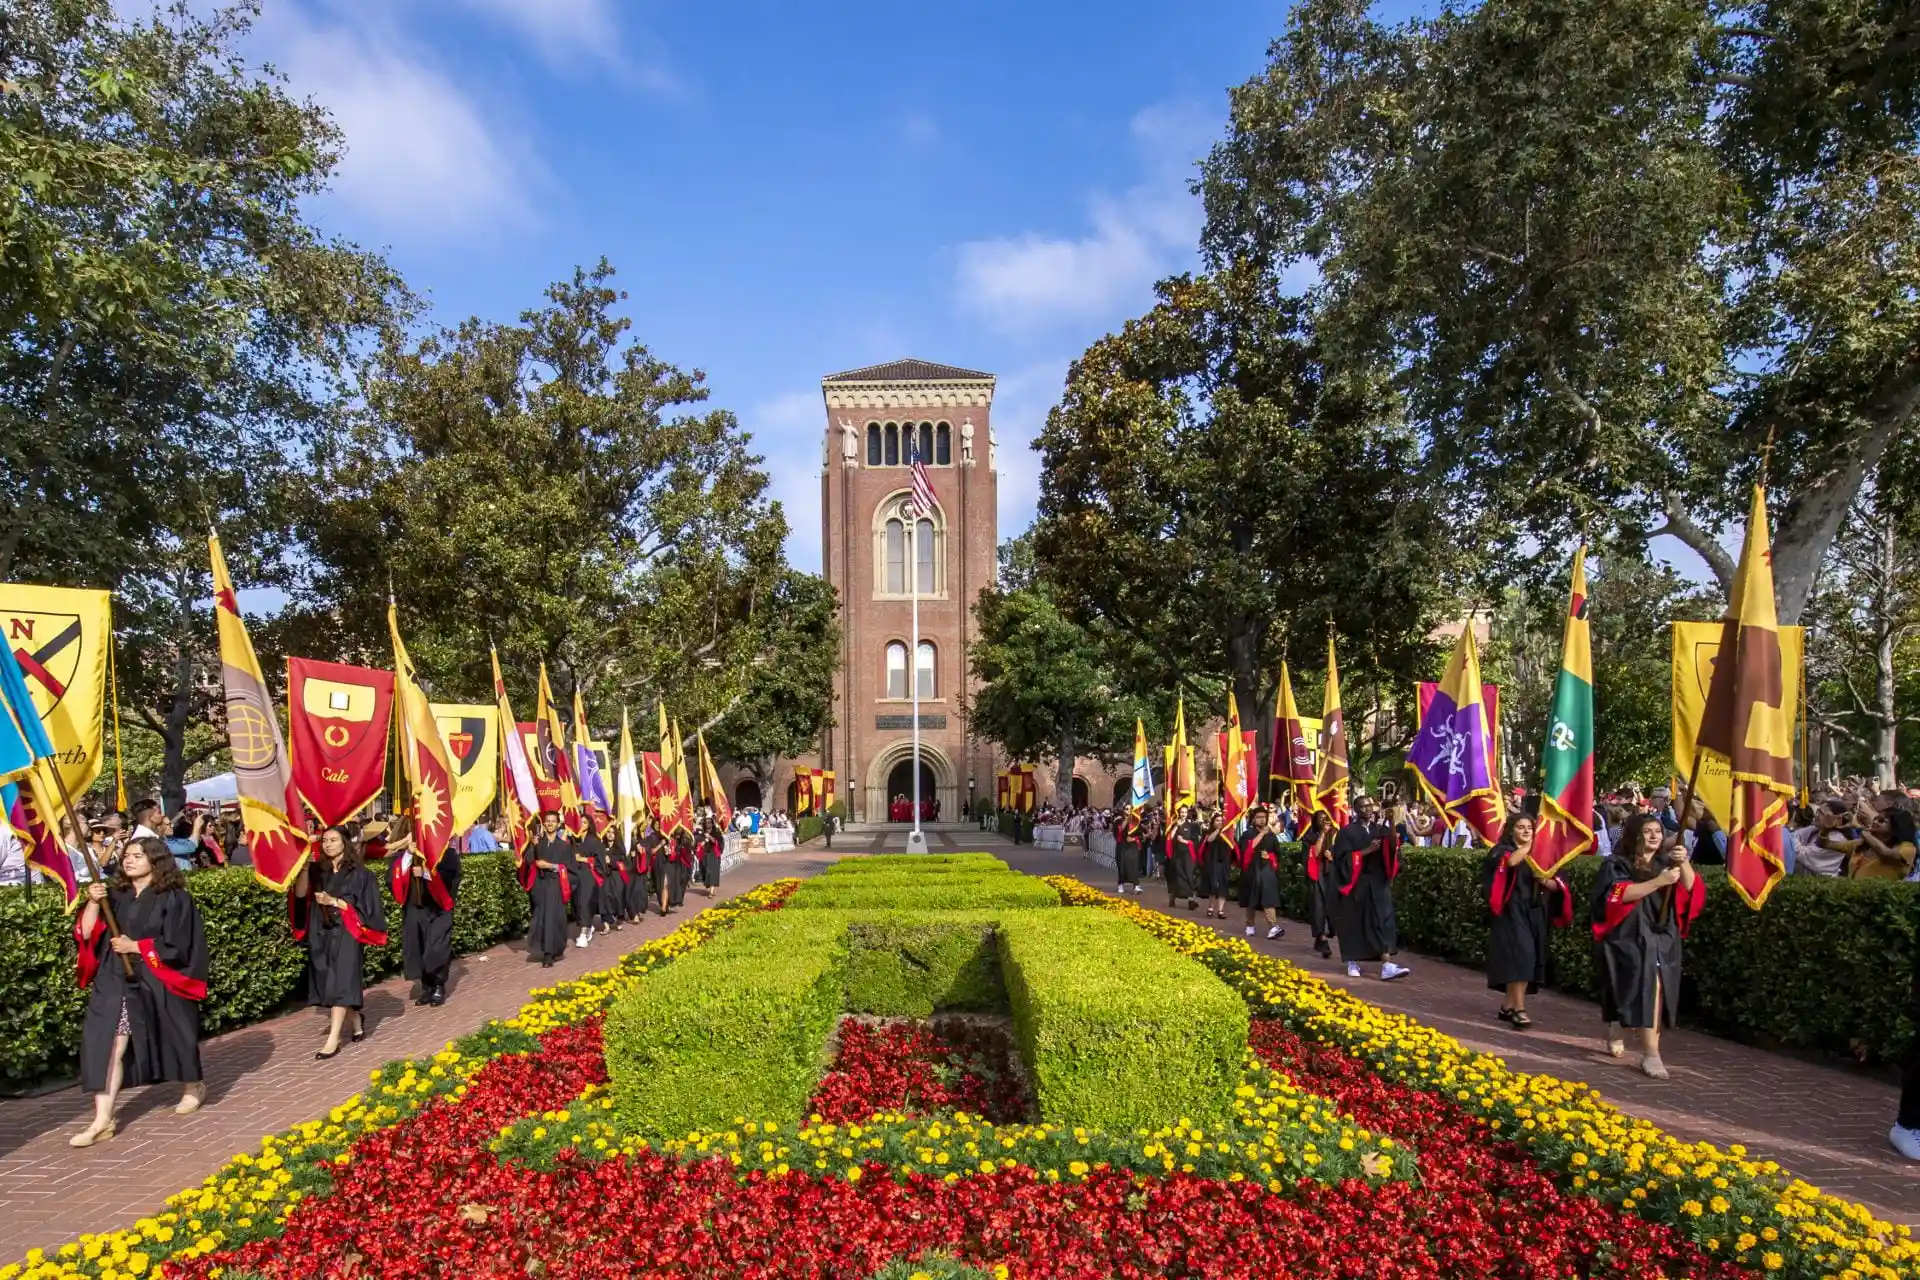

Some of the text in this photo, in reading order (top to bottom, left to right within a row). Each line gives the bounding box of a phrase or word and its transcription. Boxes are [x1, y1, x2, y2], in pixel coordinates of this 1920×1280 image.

[10, 619, 35, 640] N
[57, 745, 87, 765] rth
[321, 767, 349, 783] Cale
